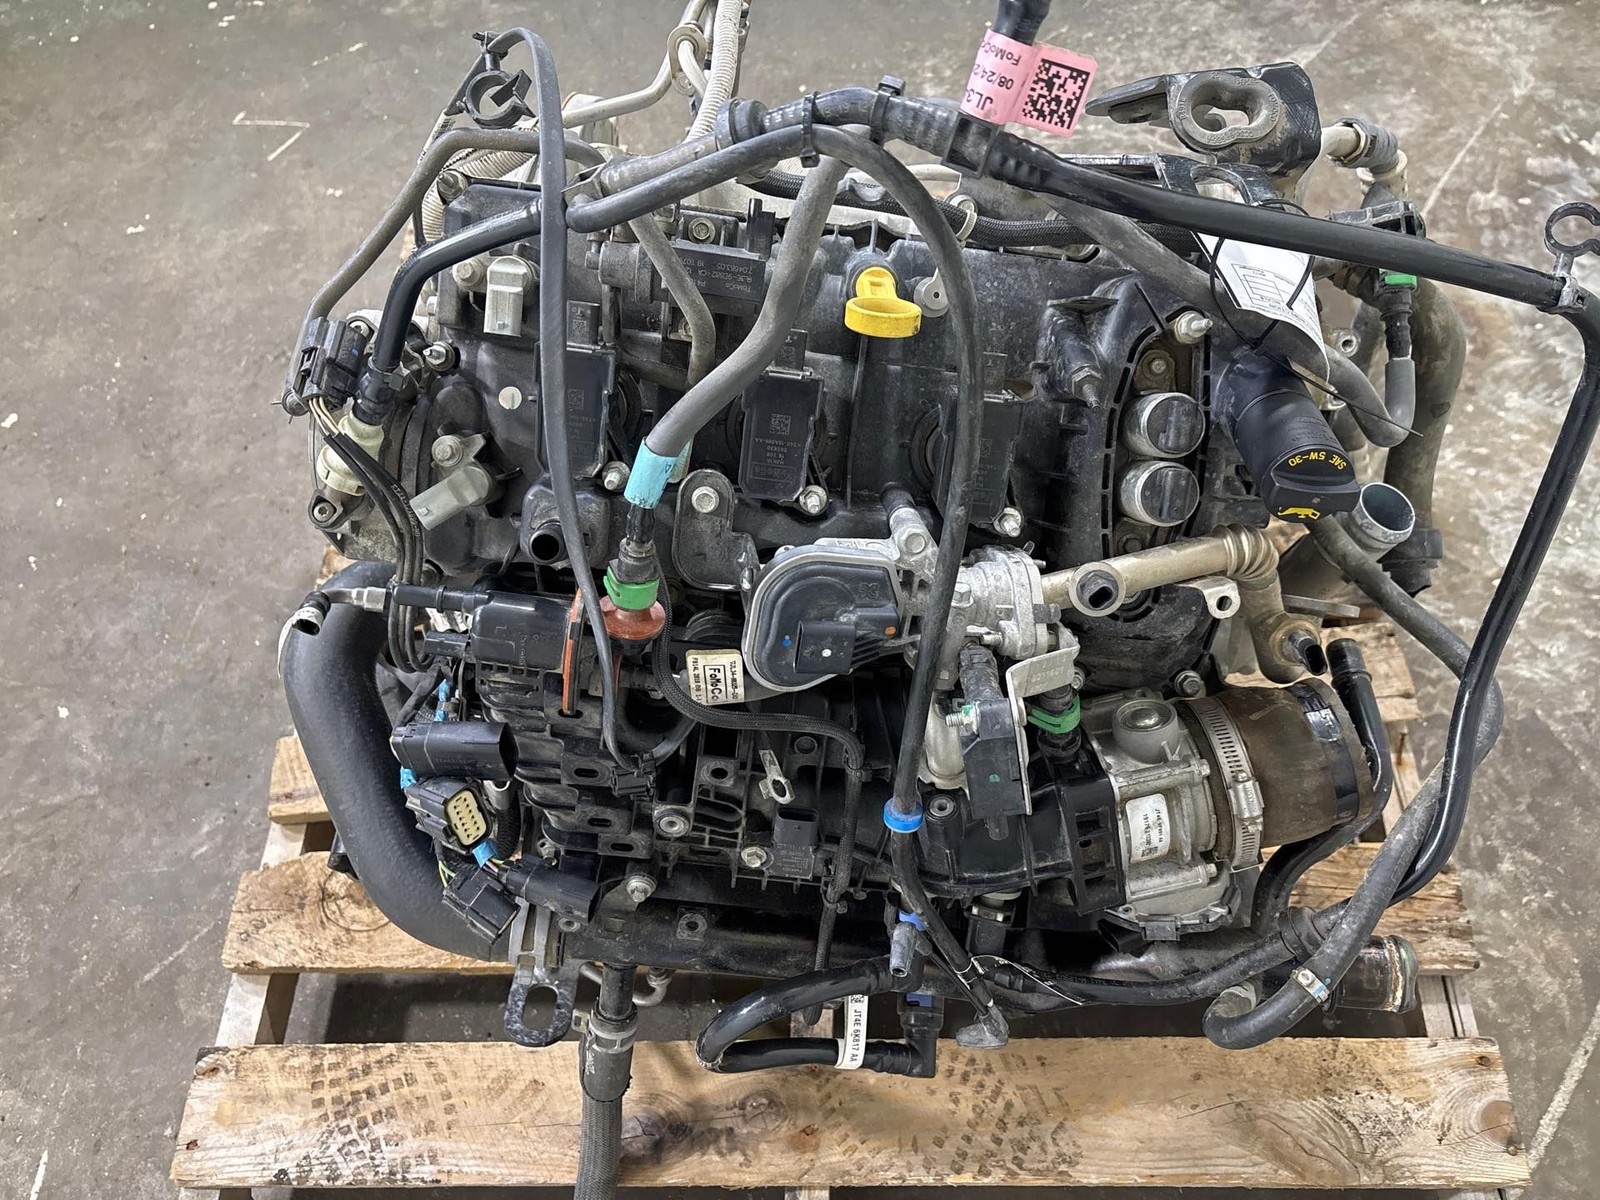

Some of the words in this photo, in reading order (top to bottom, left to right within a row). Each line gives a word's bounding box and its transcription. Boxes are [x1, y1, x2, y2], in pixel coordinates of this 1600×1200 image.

[1288, 451, 1327, 467] 5W-30
[1328, 454, 1347, 470] SAE
[708, 667, 722, 701] FoMoCo
[853, 1009, 861, 1027] JT4E
[852, 1029, 860, 1051] 6K817
[849, 1053, 858, 1062] AA
